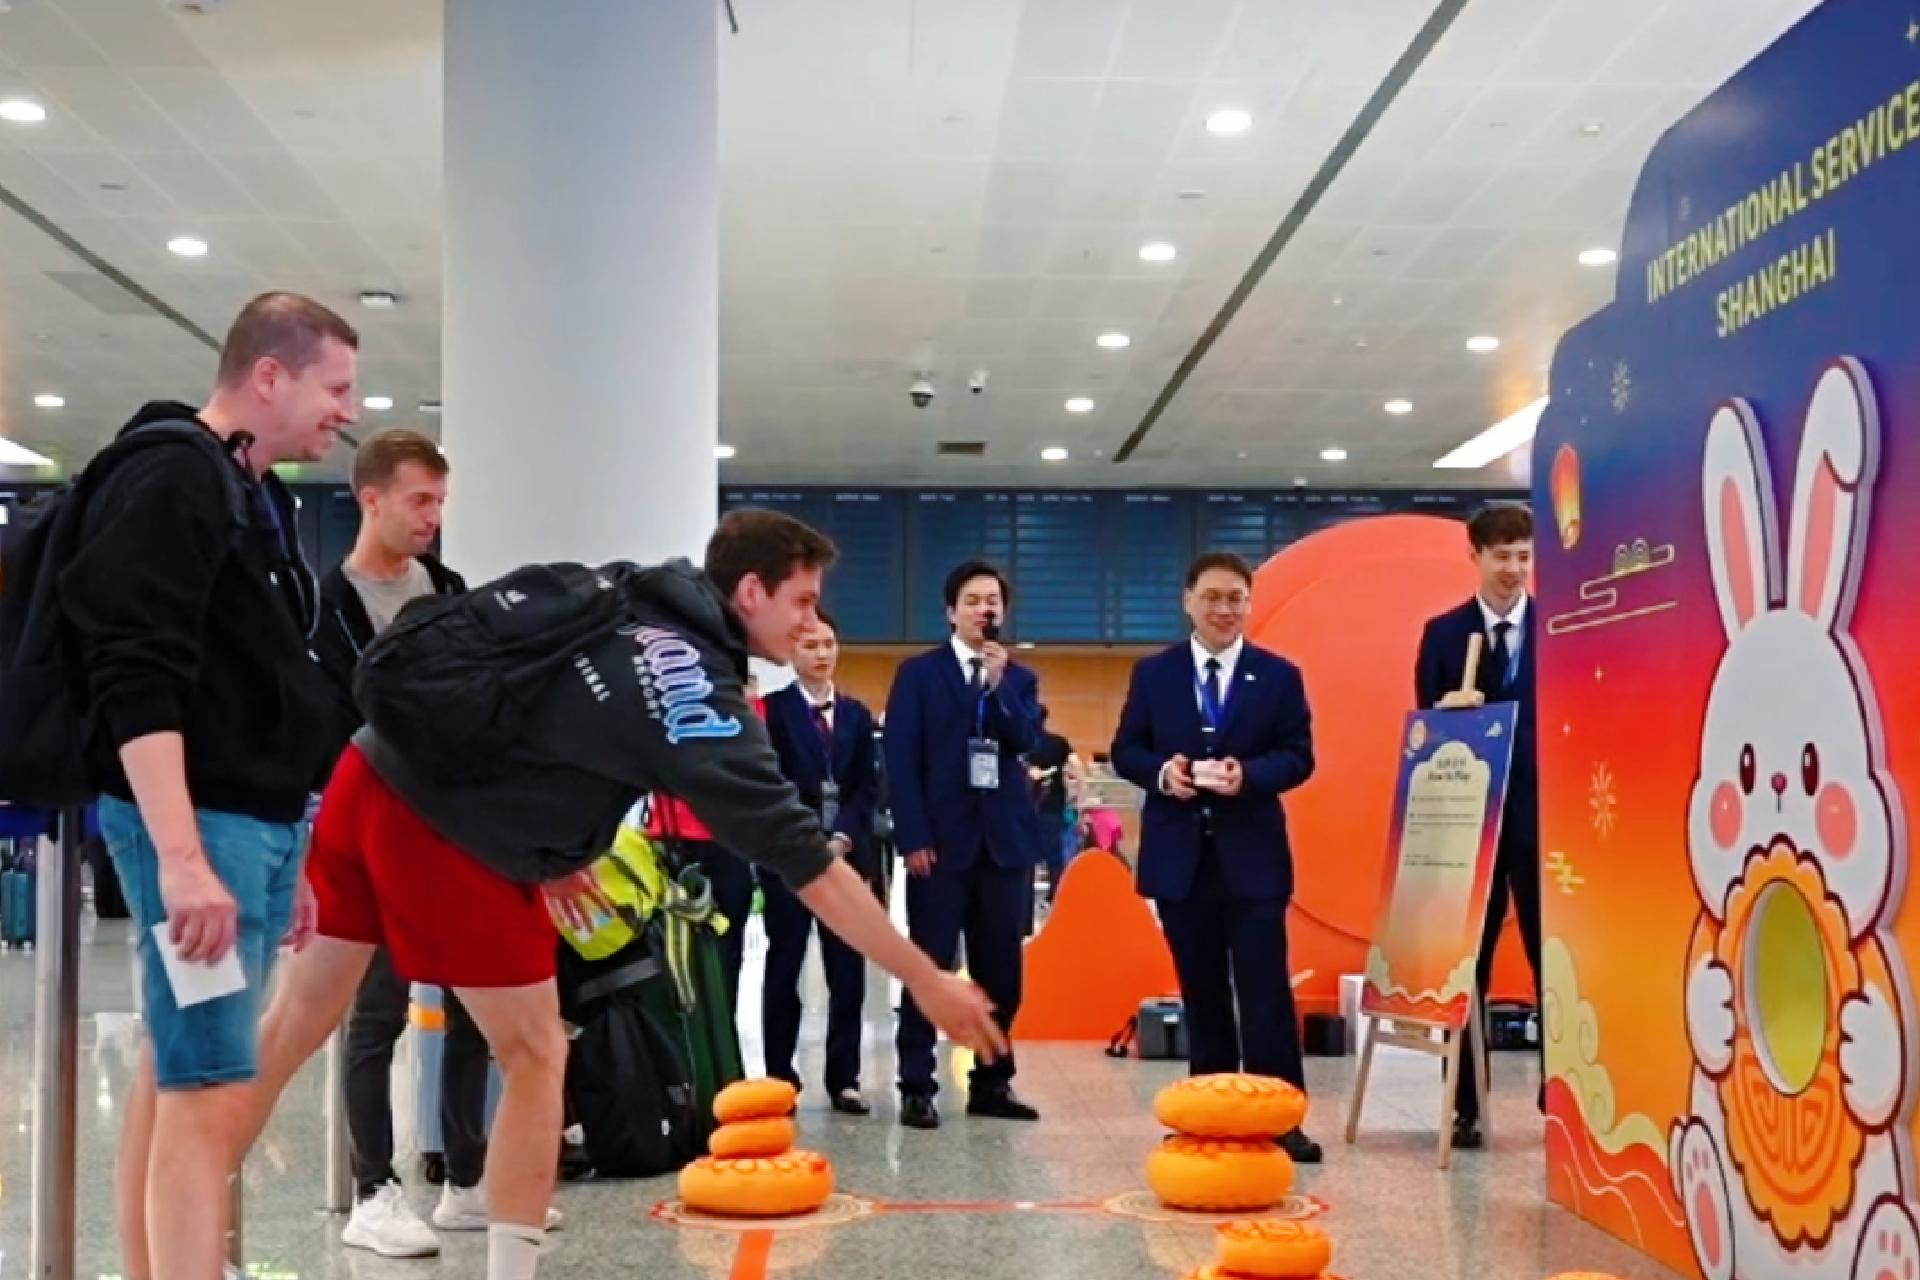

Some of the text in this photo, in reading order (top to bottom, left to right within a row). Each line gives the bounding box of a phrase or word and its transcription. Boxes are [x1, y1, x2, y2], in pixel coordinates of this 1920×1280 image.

[1647, 79, 1920, 303] INTERNATIONAL SERVICE
[1716, 228, 1835, 337] SHANGHAI
